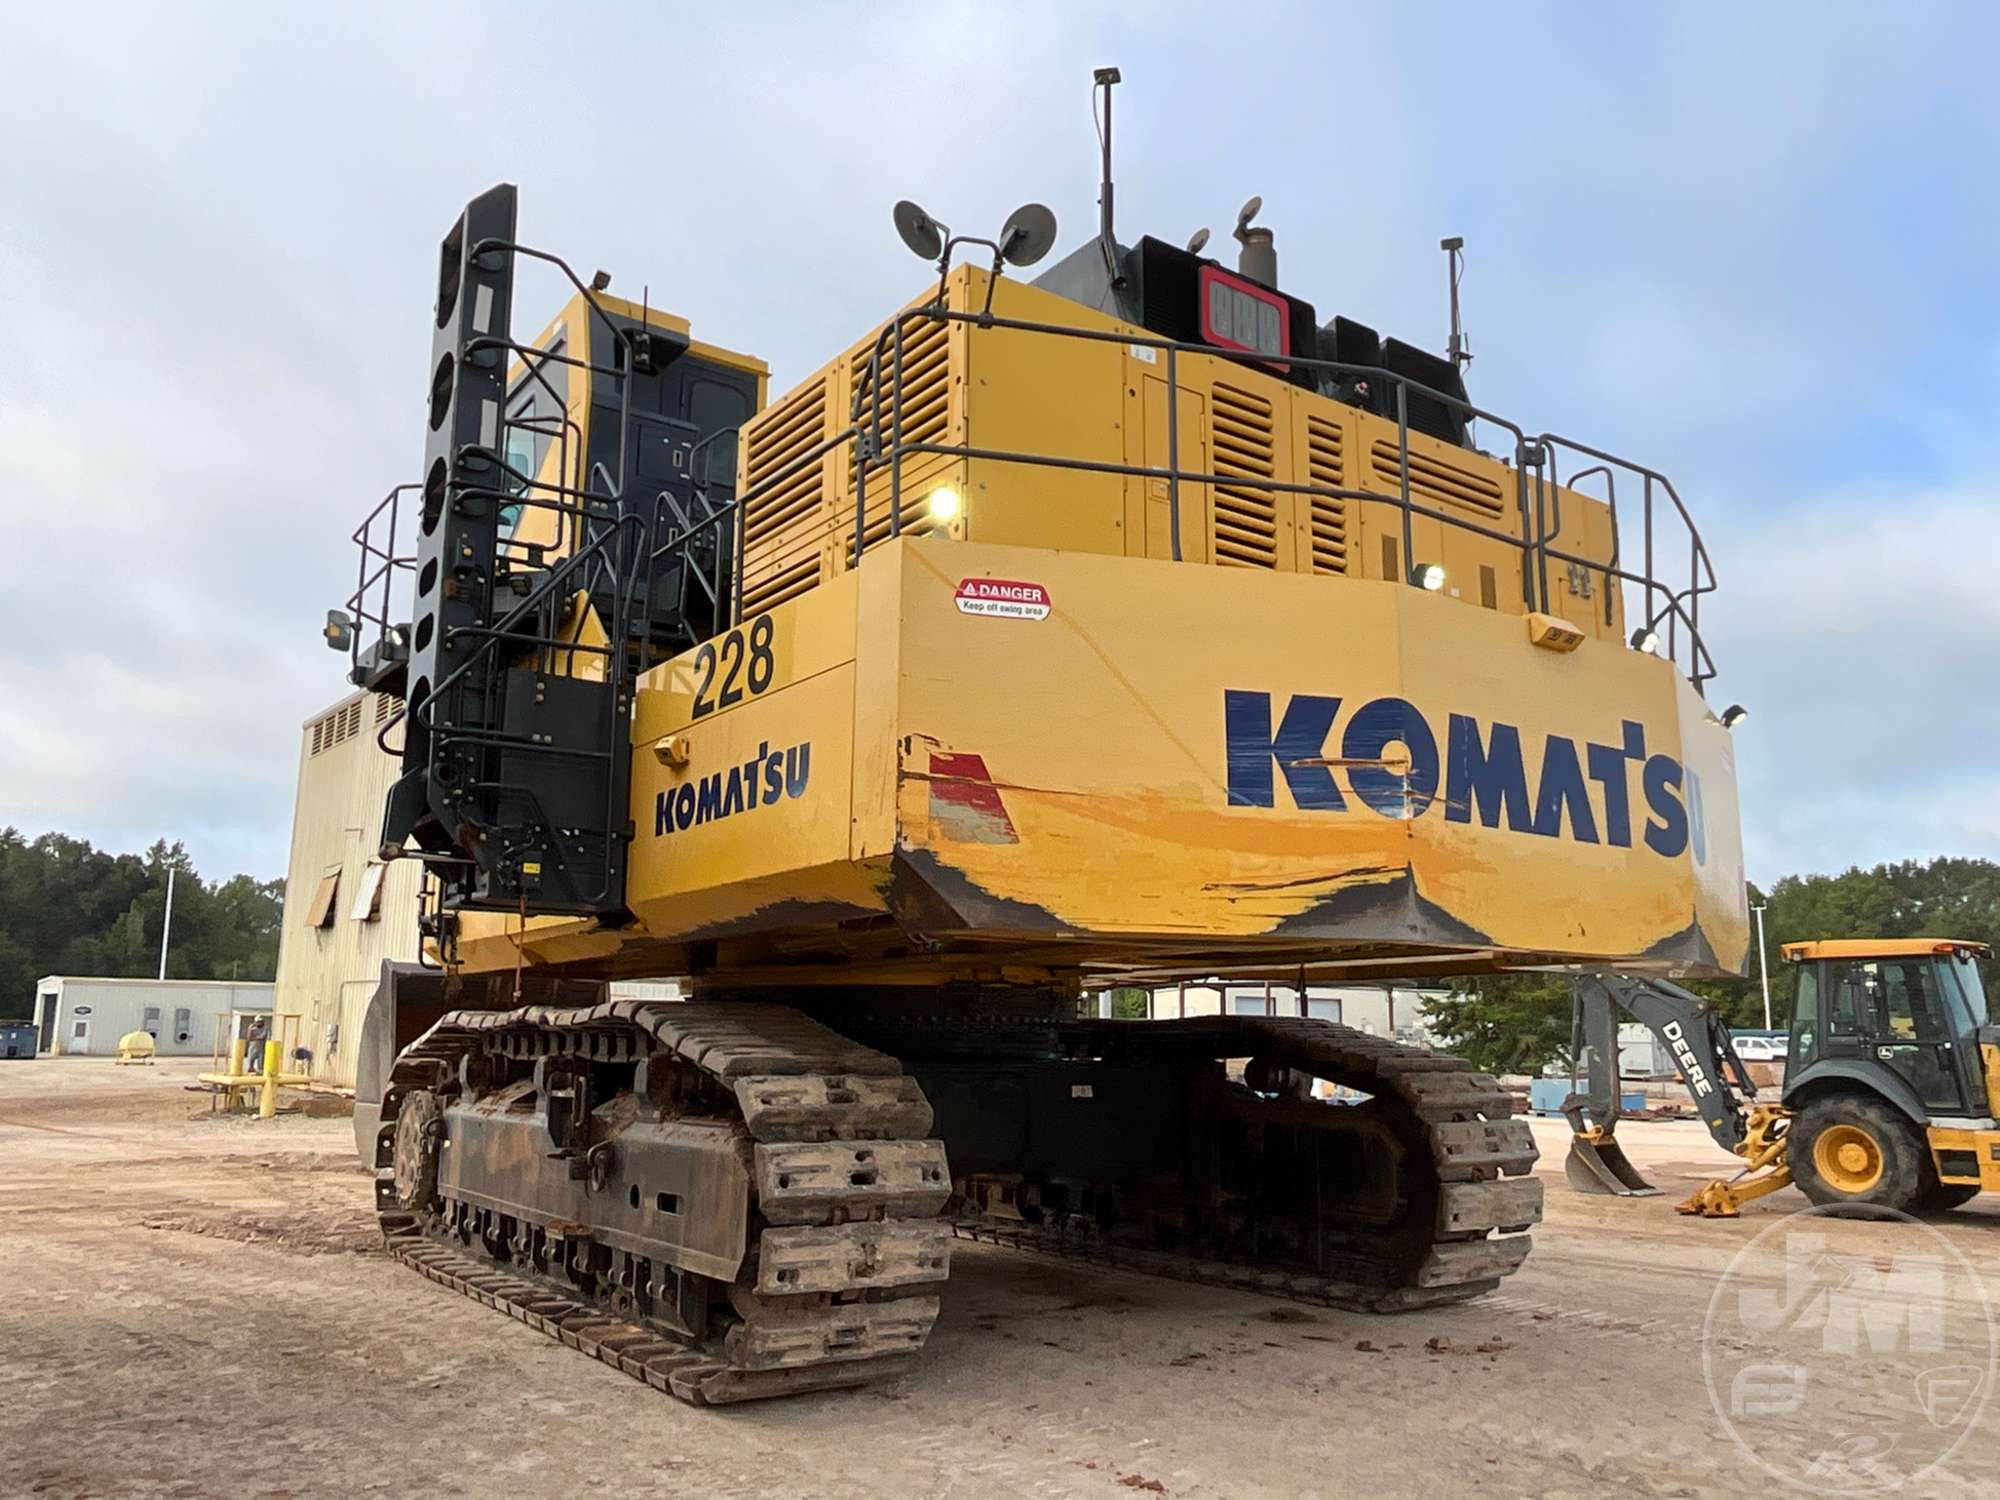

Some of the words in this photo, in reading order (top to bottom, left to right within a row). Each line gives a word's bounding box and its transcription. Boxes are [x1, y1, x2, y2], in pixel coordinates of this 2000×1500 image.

[963, 600, 984, 612] Keep
[986, 604, 998, 612] off
[999, 605, 1023, 615] swing
[1025, 608, 1043, 616] area
[979, 584, 1042, 602] DANGER
[692, 614, 774, 720] 228
[655, 741, 811, 837] KOMATSU
[1224, 689, 1706, 867] KOMATSU
[1662, 1021, 1713, 1097] DEERE
